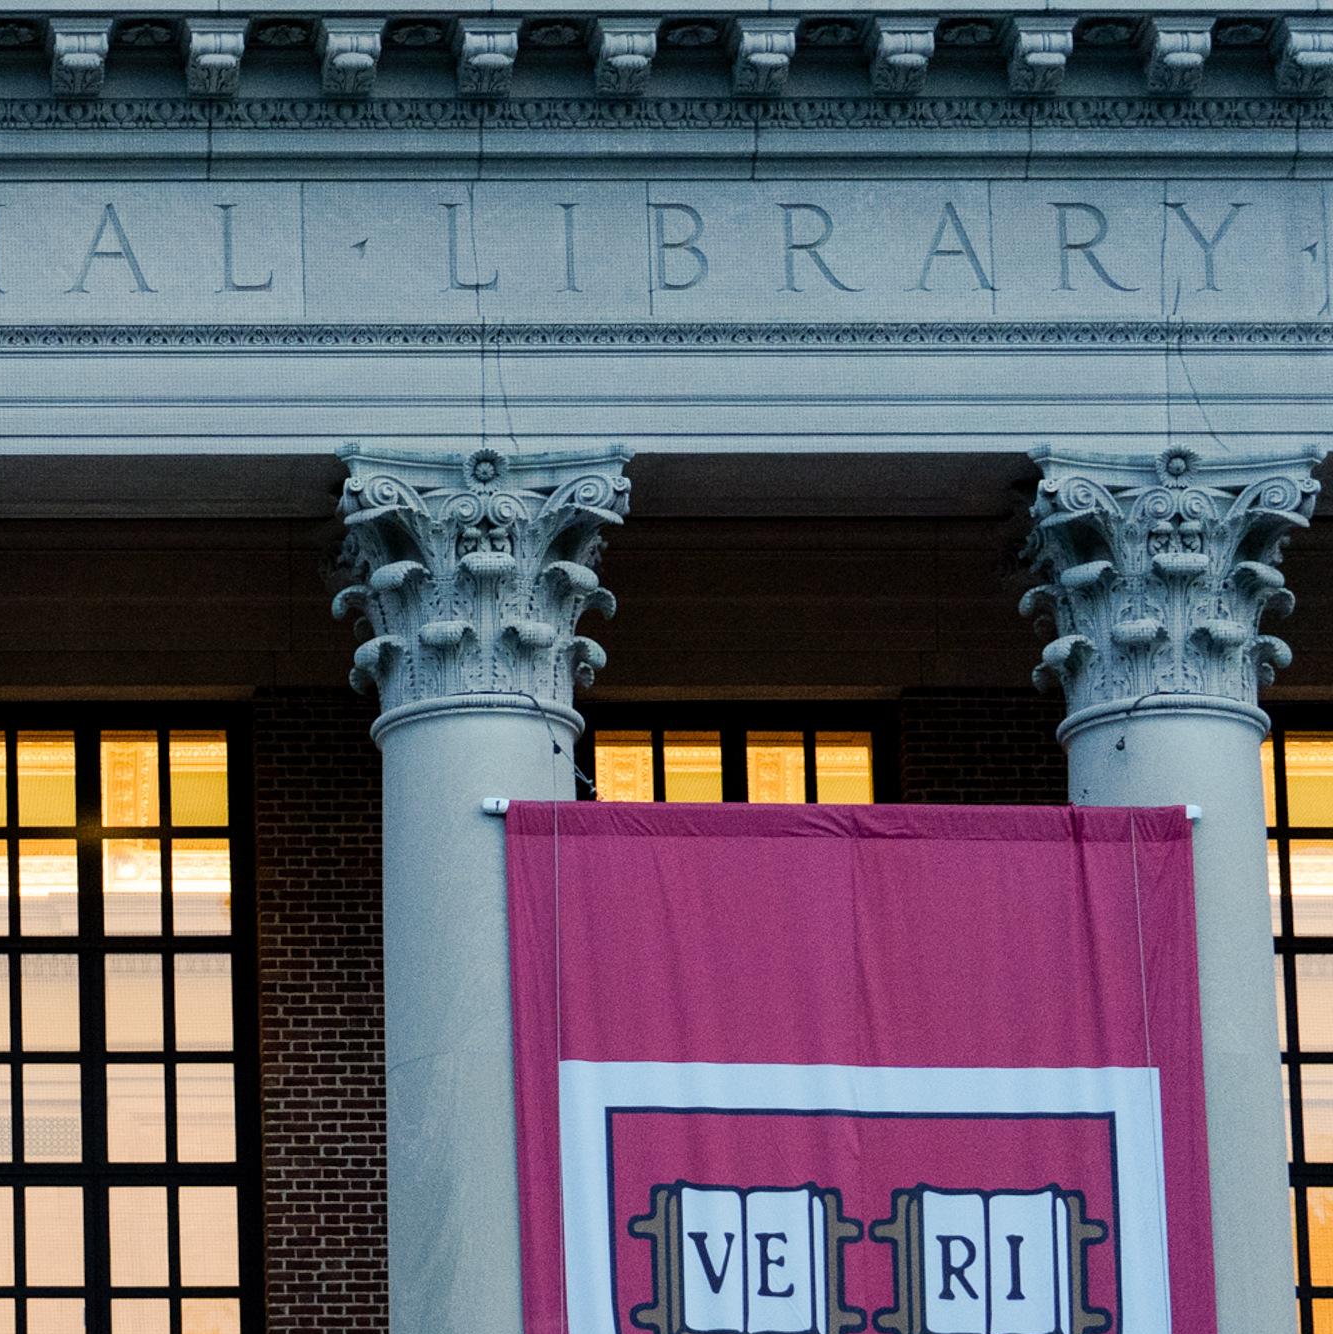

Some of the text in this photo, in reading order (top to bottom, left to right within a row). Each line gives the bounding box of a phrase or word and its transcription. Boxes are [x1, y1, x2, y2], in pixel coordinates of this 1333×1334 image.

[436, 201, 1251, 294] LIBRARY
[686, 1231, 1026, 1301] VE RI
